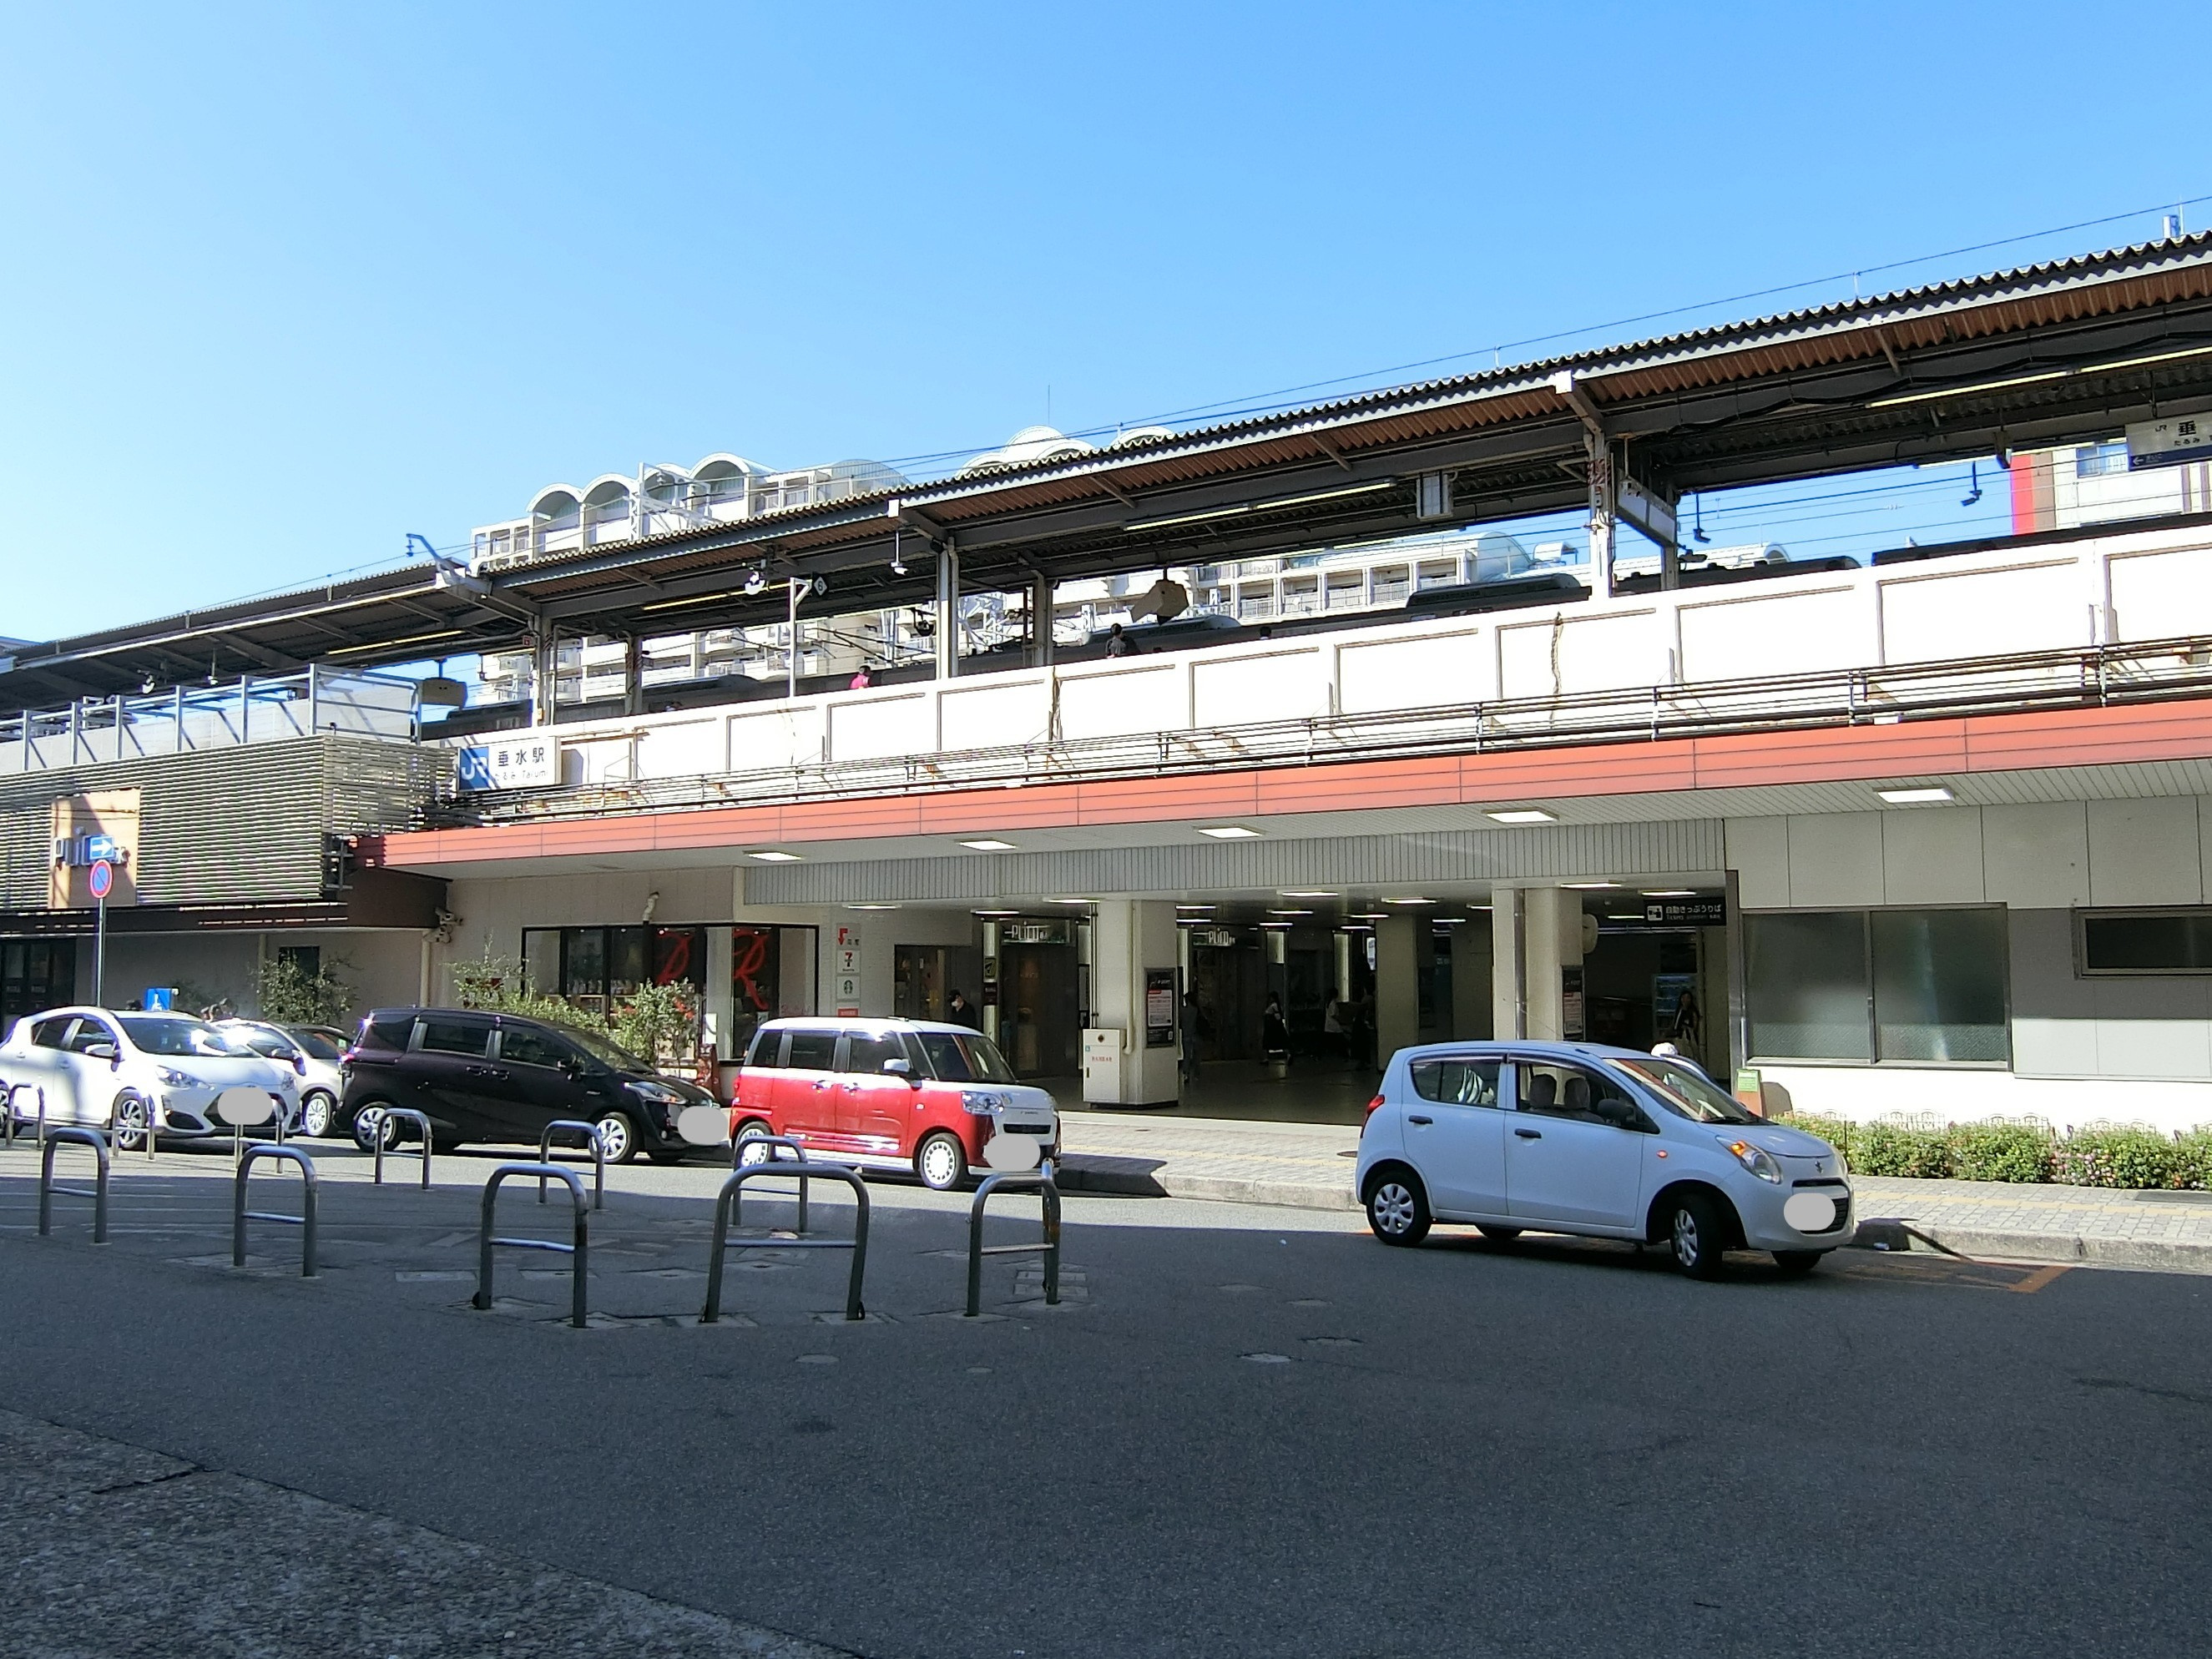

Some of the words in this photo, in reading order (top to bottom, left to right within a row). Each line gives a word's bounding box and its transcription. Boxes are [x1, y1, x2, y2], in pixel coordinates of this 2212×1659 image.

[2154, 424, 2167, 432] JR
[2174, 437, 2200, 447] たるみ
[817, 580, 824, 592] 6
[497, 747, 545, 767] 垂水駅
[1665, 904, 1721, 914] 自動きっぷうりば
